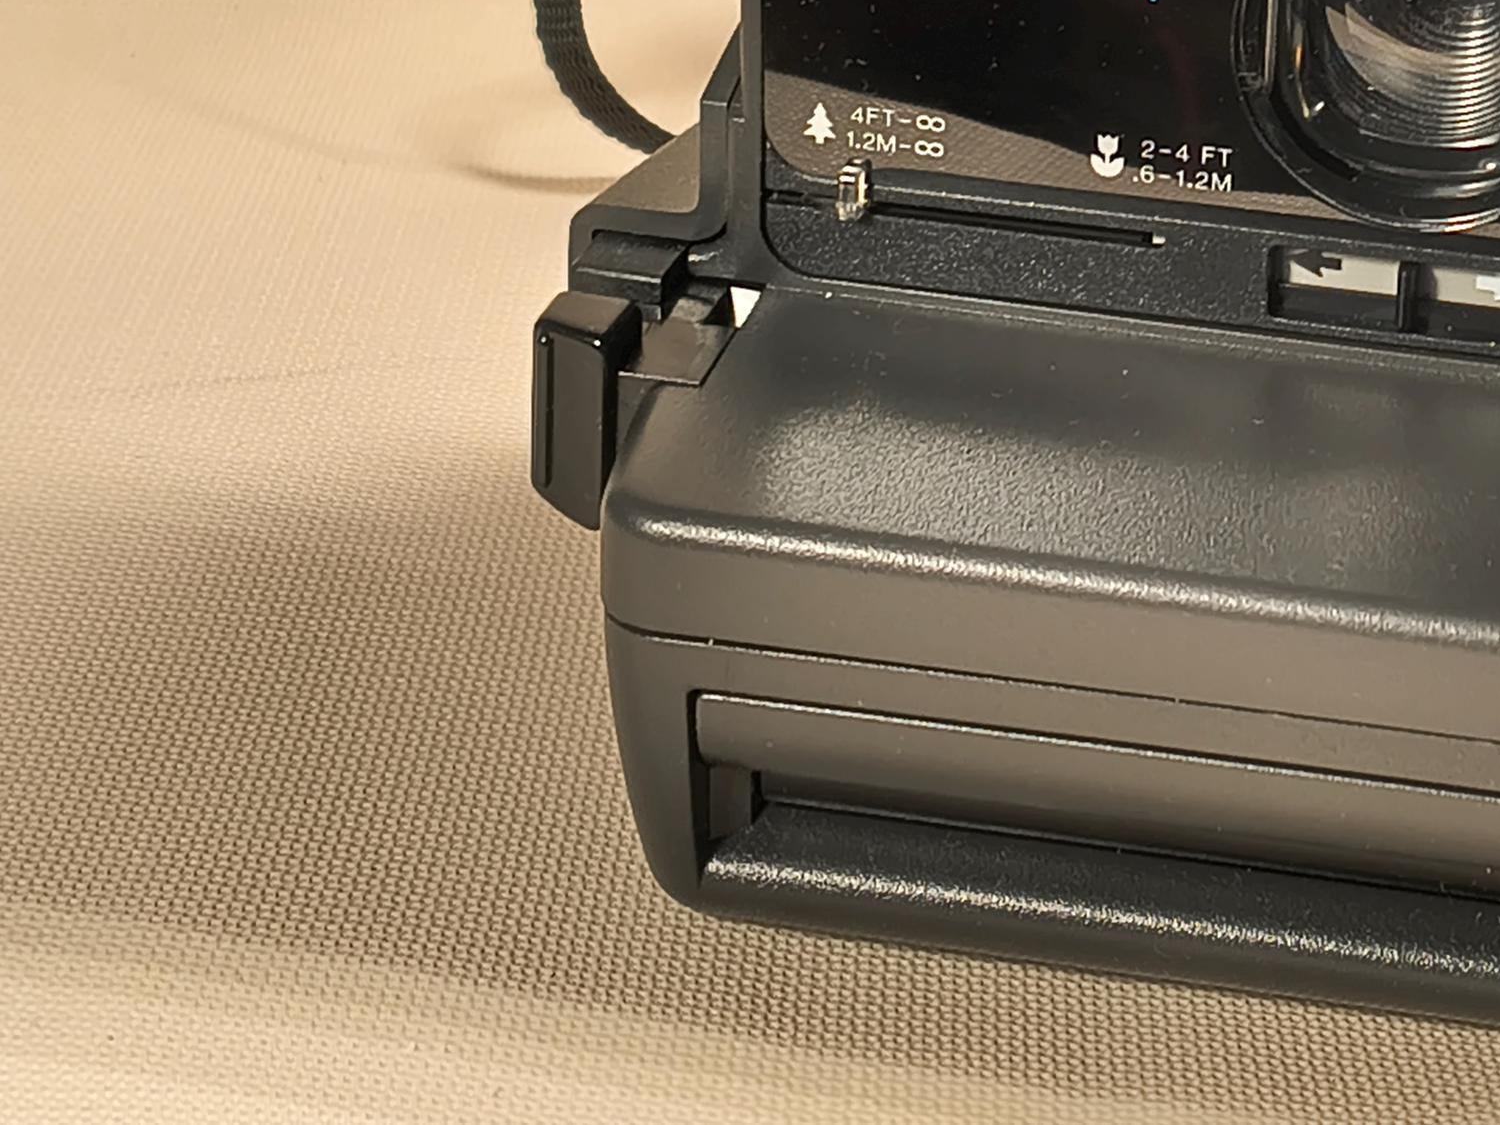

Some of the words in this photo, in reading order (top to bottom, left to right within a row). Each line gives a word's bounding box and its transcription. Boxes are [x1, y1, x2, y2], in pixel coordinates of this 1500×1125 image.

[1140, 139, 1190, 163] 2-4
[1201, 145, 1233, 168] FT
[1132, 164, 1232, 193] .6-1.2M
